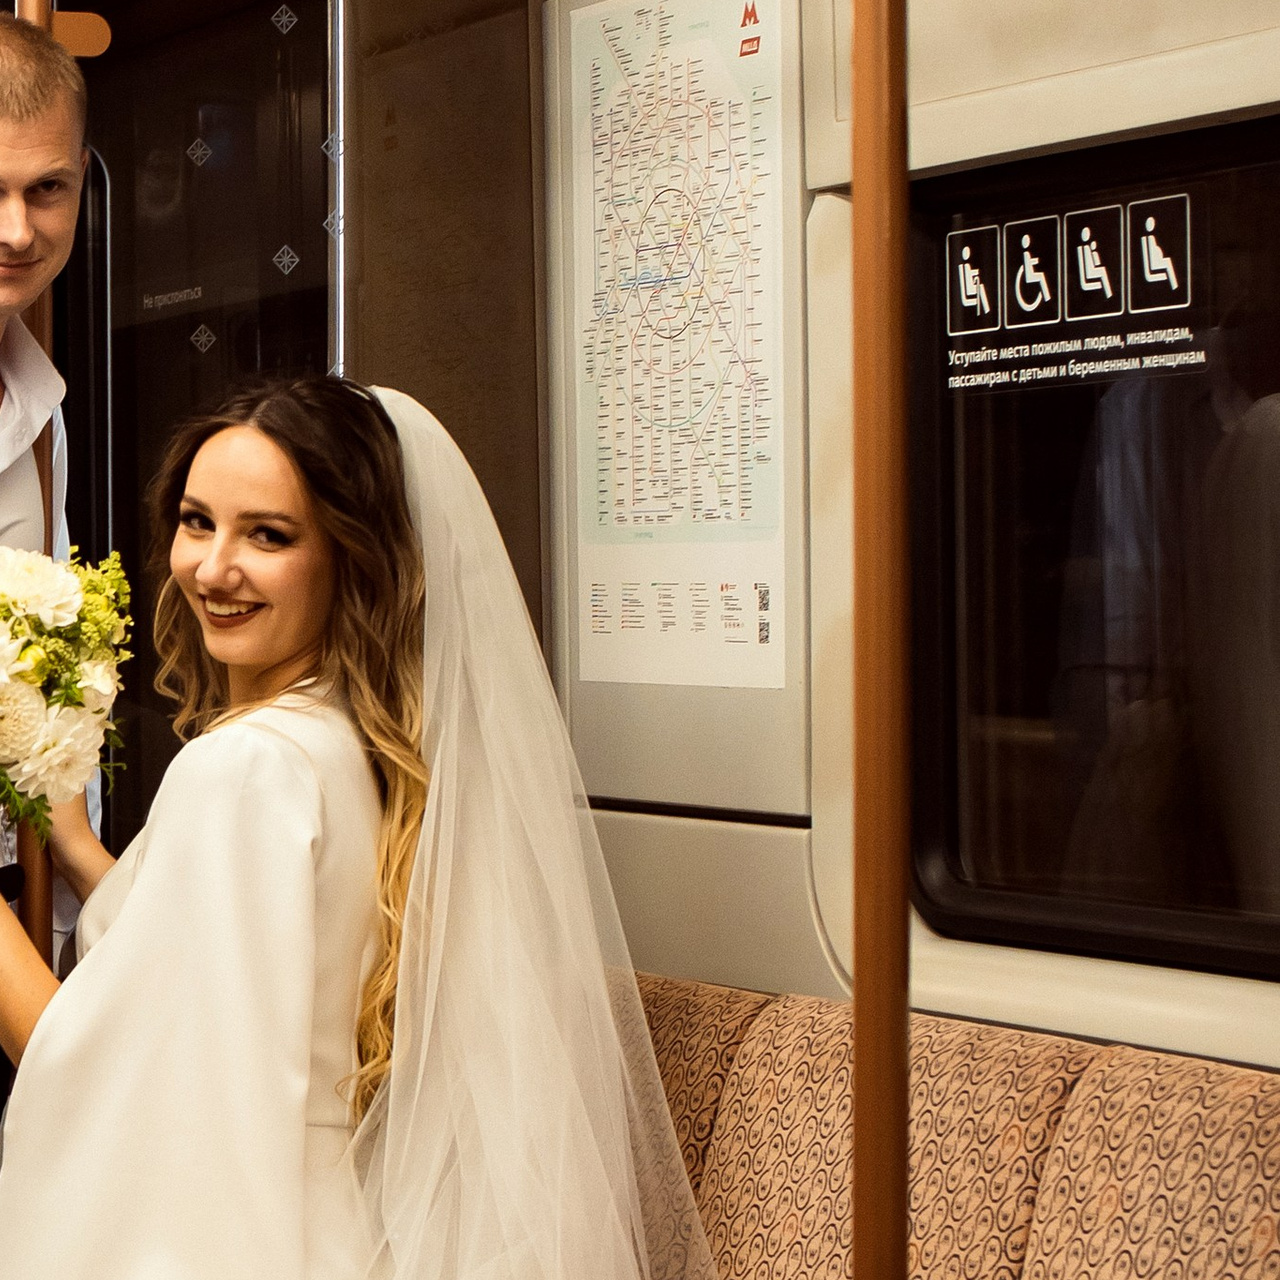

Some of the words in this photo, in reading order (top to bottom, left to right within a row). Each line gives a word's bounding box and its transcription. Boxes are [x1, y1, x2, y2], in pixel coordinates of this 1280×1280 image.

[948, 346, 998, 368] Уступайте
[999, 344, 1030, 360] места
[1031, 338, 1082, 357] пожилым
[1083, 334, 1125, 352] людям,
[1126, 326, 1194, 346] инвалидам,
[948, 370, 1011, 389] пассажирам
[1011, 369, 1019, 382] с
[1018, 365, 1058, 384] детьми
[1059, 364, 1067, 377] и
[1067, 357, 1141, 378] беременным
[1141, 350, 1206, 369] женщинам
